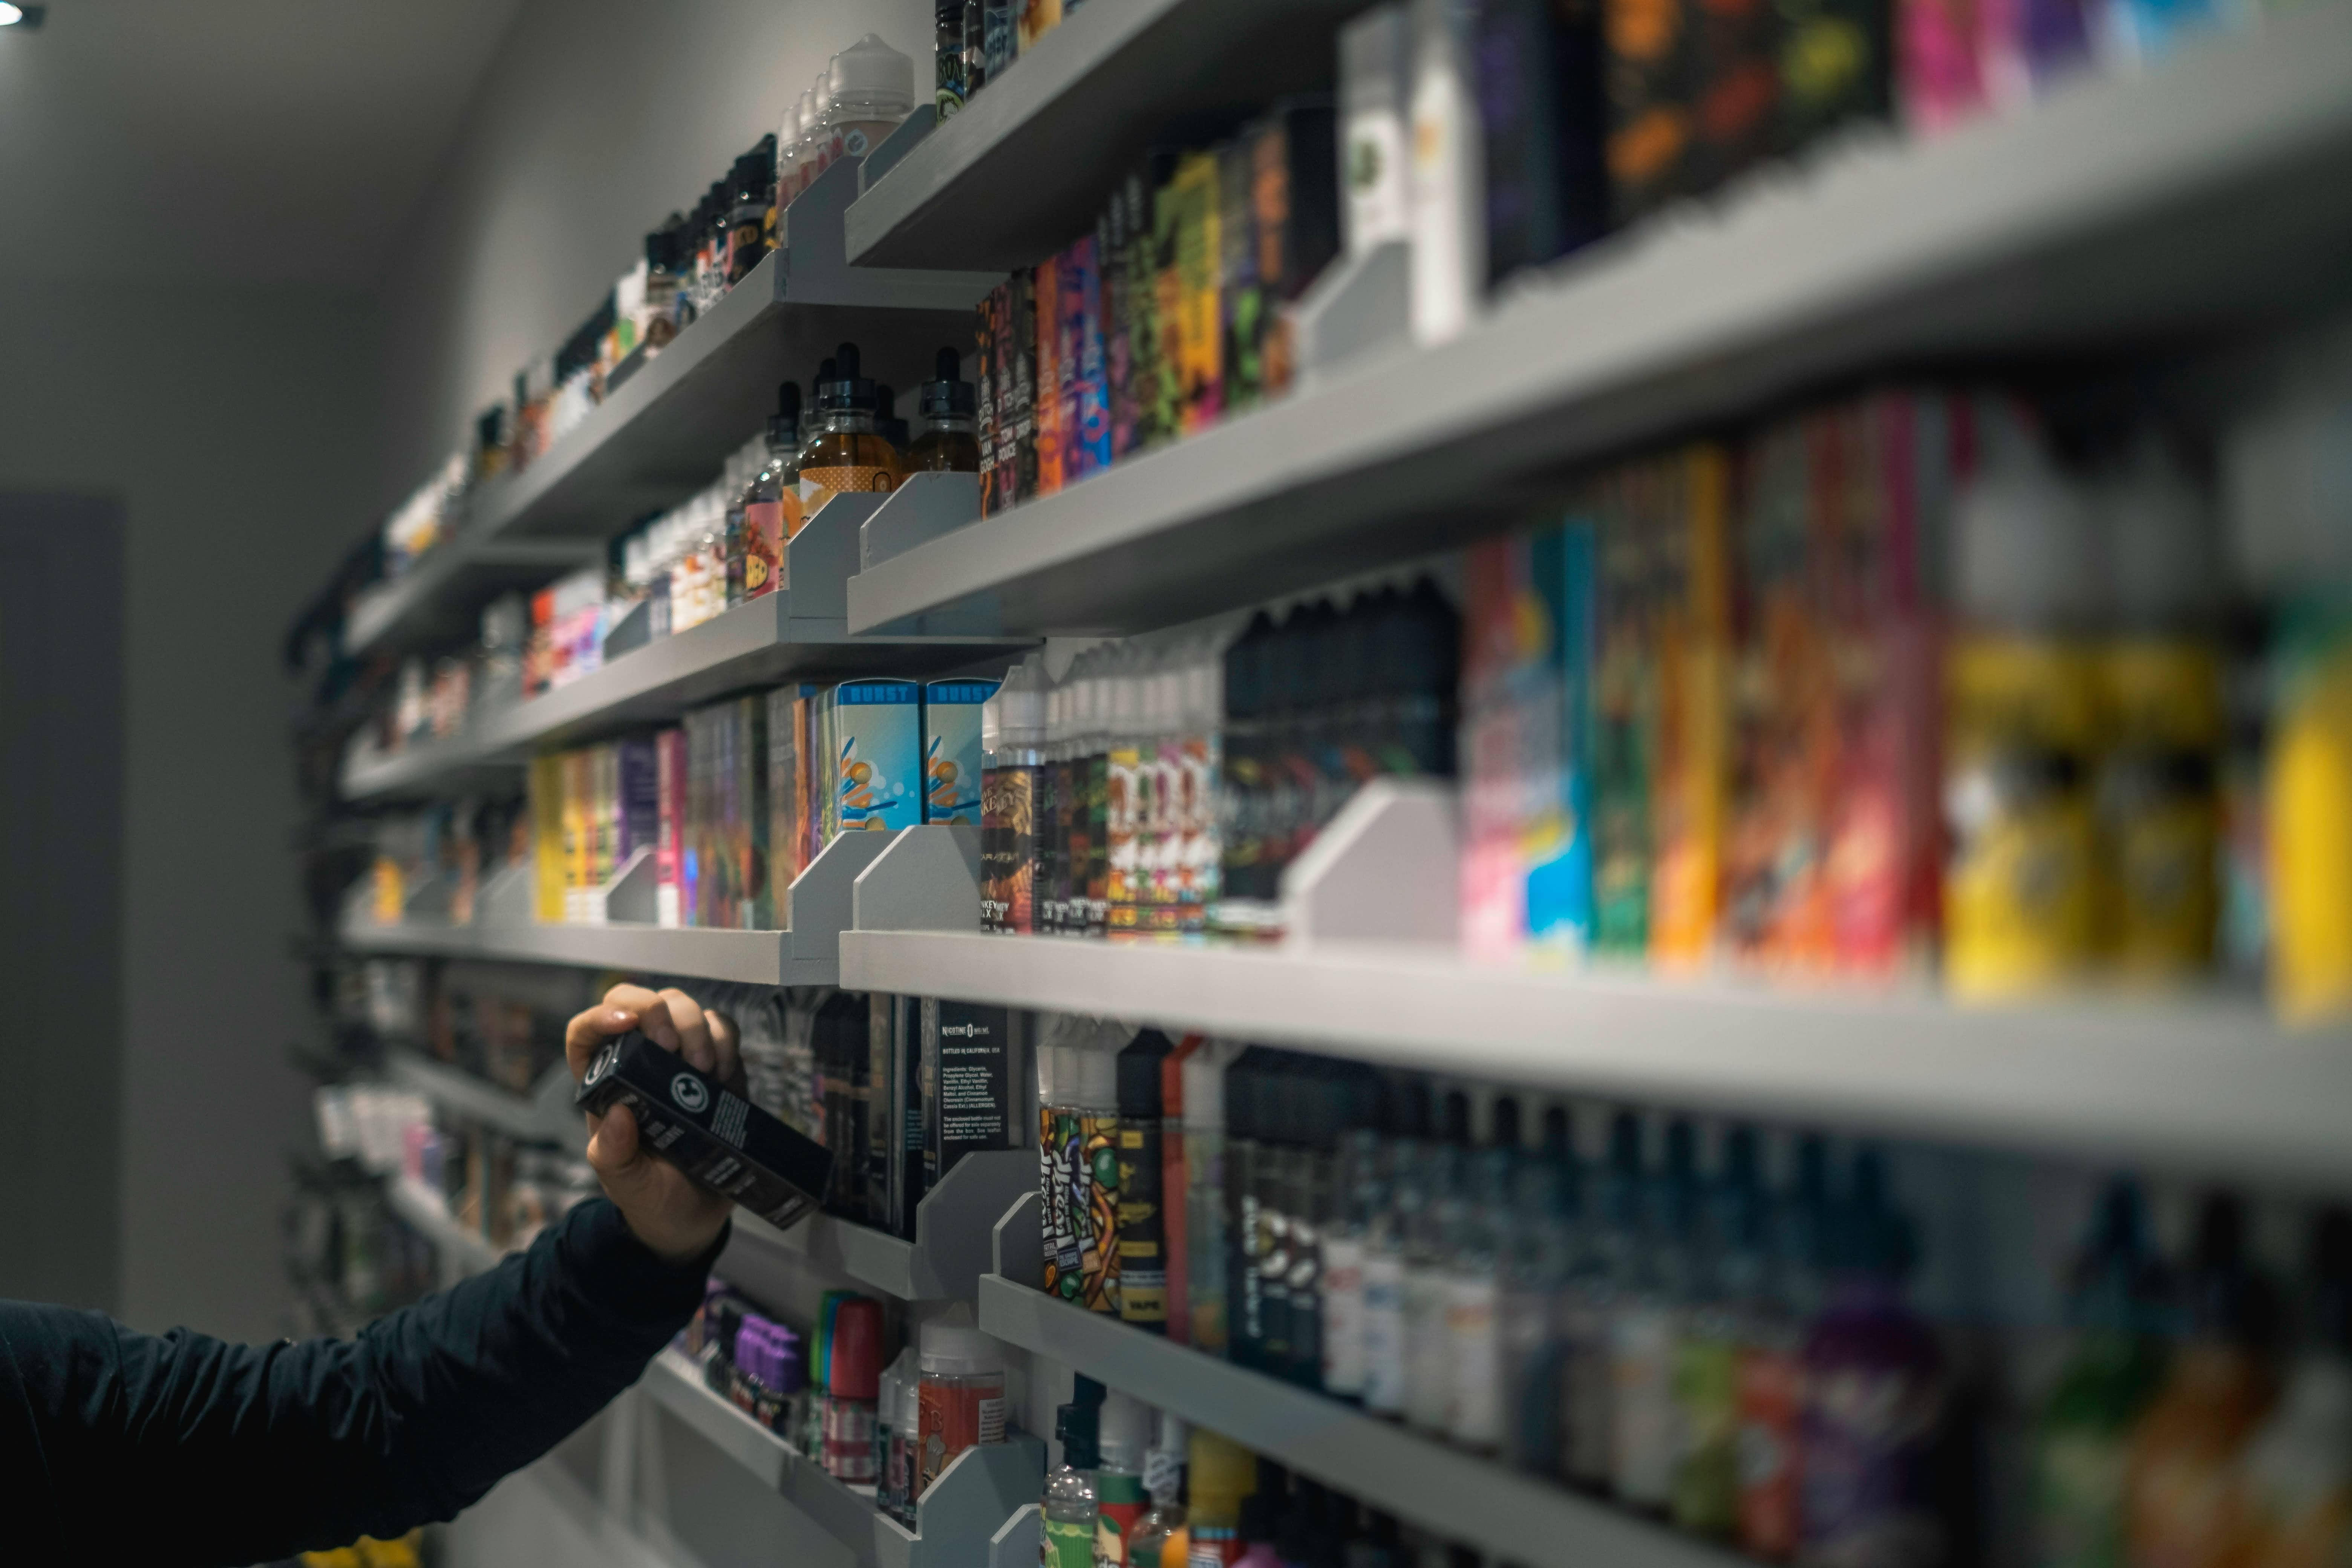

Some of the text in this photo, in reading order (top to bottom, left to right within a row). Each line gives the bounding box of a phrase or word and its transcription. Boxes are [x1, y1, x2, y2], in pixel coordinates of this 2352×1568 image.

[851, 687, 908, 702] BURST
[942, 1027, 966, 1037] NICOTINE
[968, 1024, 973, 1037] 0
